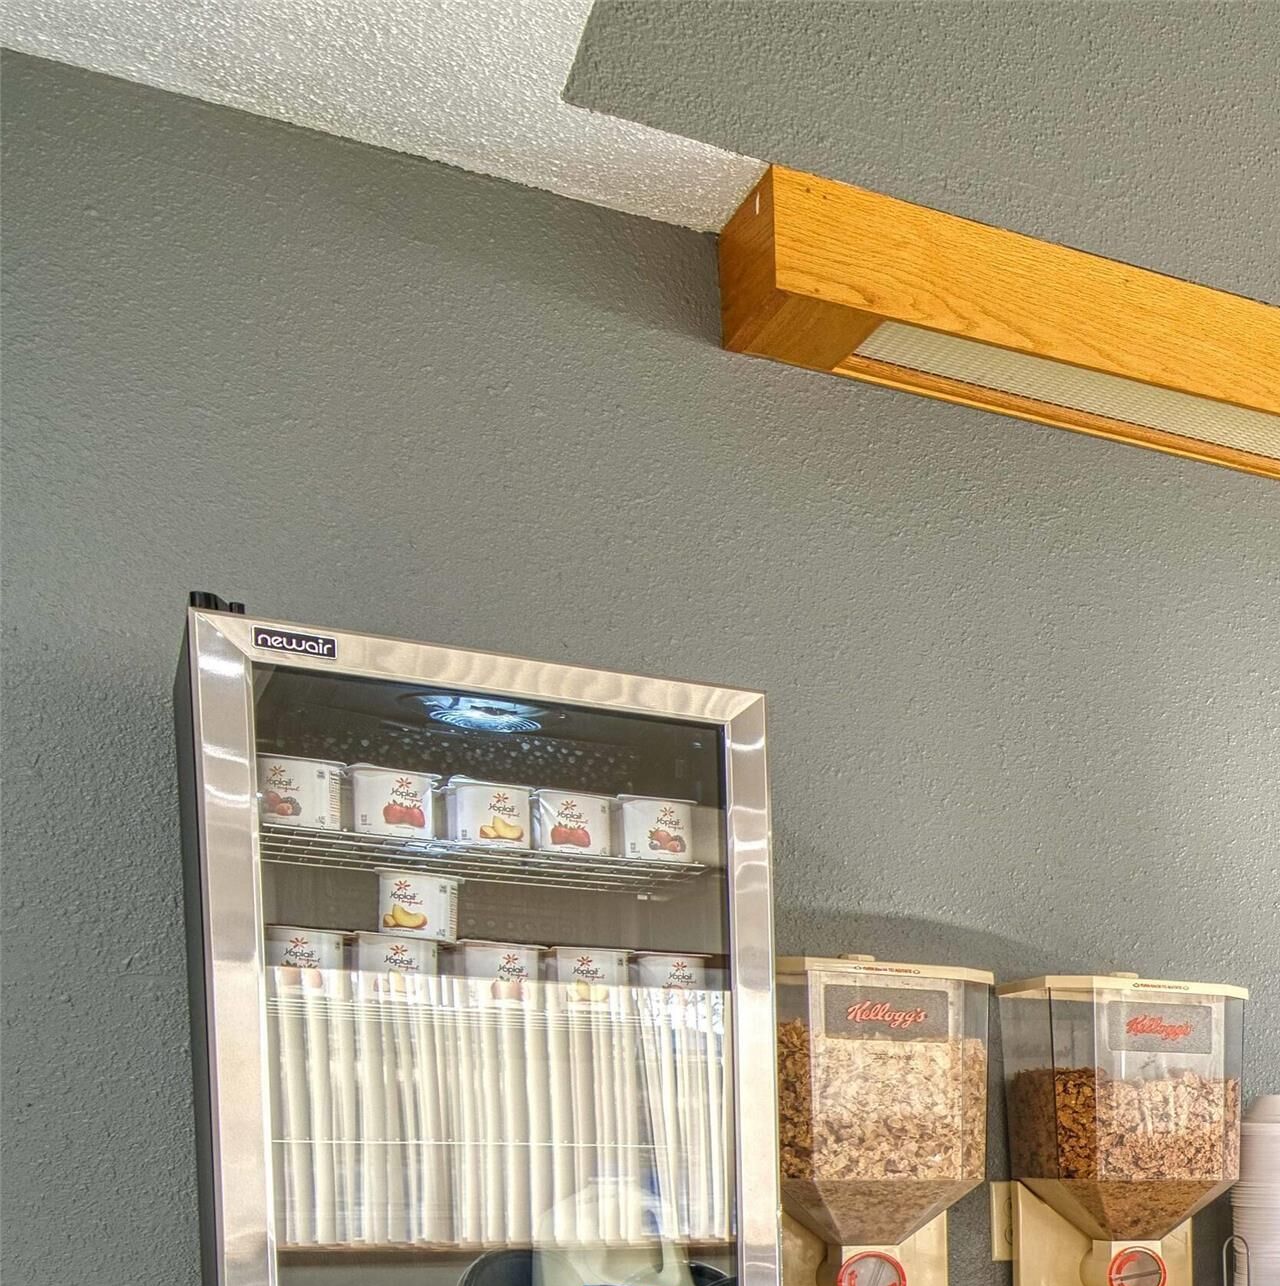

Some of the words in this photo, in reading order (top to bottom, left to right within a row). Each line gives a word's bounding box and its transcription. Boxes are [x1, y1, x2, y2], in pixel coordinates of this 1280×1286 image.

[257, 633, 332, 655] newair
[266, 777, 292, 787] Yoplait
[390, 788, 418, 799] Yoplait
[488, 803, 515, 813] Yoplait
[556, 810, 583, 820] Yoplait
[656, 817, 680, 827] Yoplait
[390, 890, 417, 901] Yoplait
[284, 947, 314, 959] Yoplait
[384, 955, 414, 966] Yoplait
[498, 964, 524, 974] Yoplait
[572, 966, 599, 976] Yoplait
[668, 971, 692, 981] Yoplait
[847, 1000, 928, 1029] Kellogg's
[1126, 1014, 1193, 1041] Kellogg's
